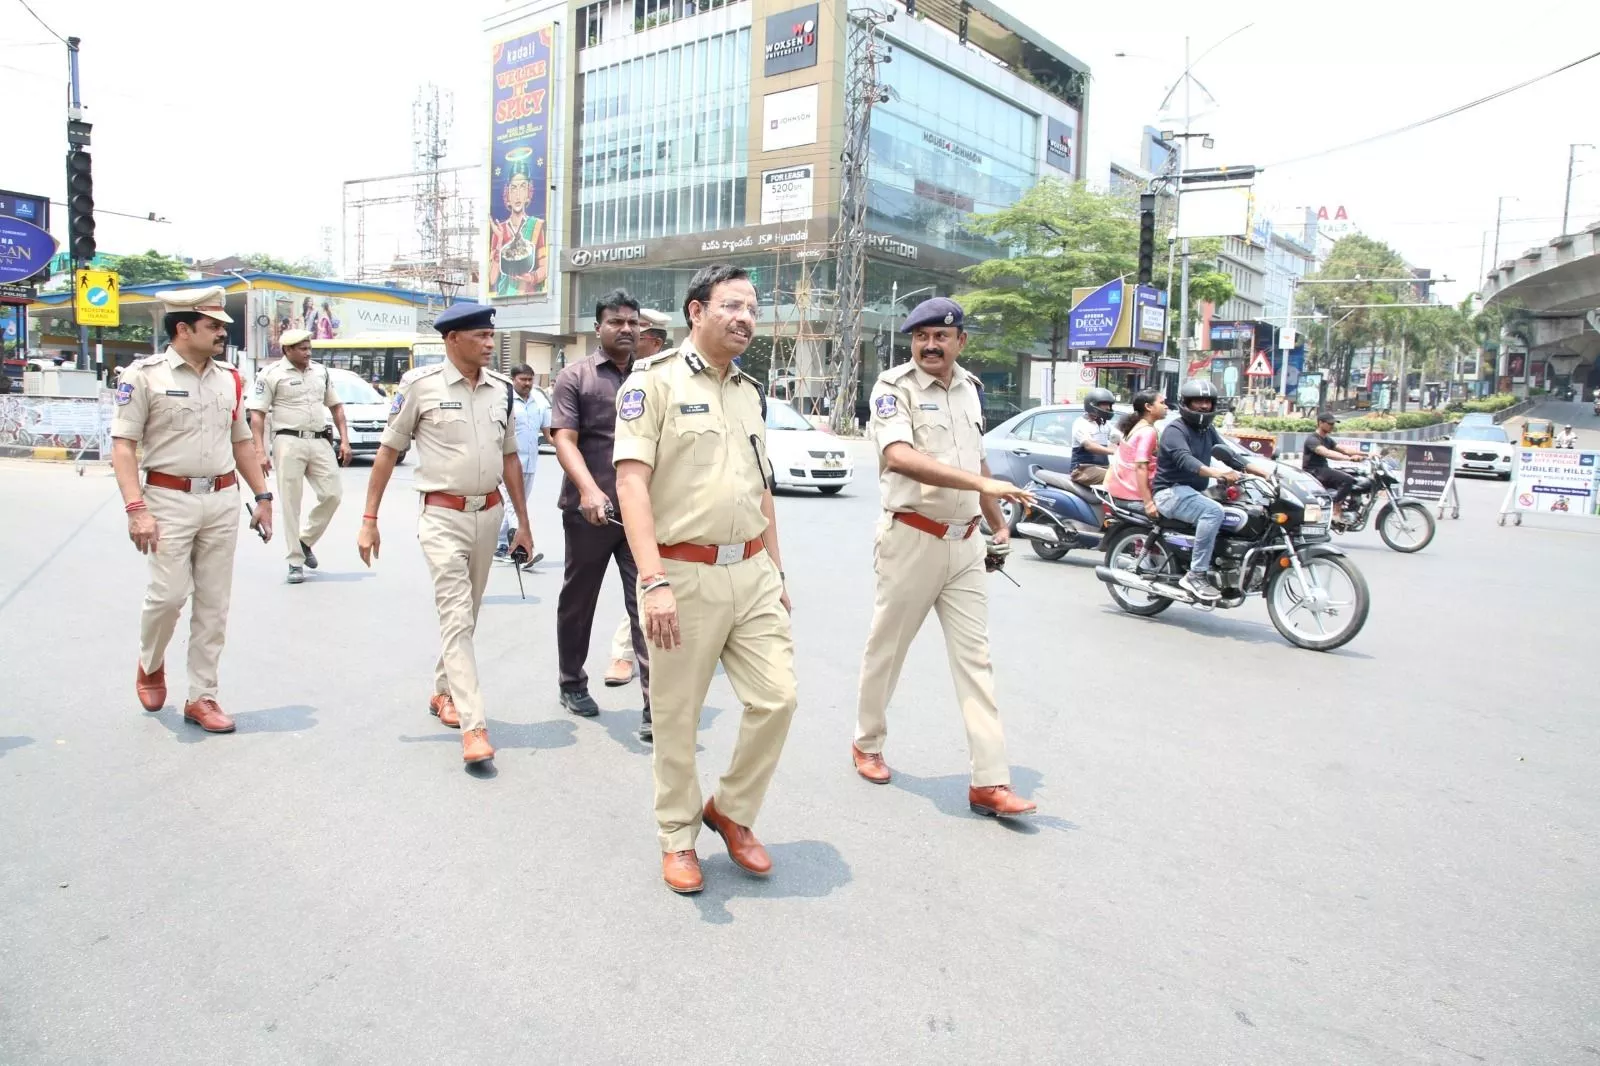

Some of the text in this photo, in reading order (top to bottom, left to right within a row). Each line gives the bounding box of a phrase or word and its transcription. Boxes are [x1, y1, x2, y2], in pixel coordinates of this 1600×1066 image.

[766, 36, 803, 54] WOXSEN
[495, 89, 546, 124] SPICY
[779, 113, 811, 124] JOHNSON
[770, 170, 805, 182] FOR LEASE
[758, 229, 809, 245] JSP Hyundai
[593, 244, 646, 262] HYUNDAI
[870, 234, 918, 260] HYUNDAI
[357, 308, 410, 325] VAARAHI
[1075, 317, 1113, 329] DECCAN
[1520, 465, 1593, 475] JUBILEE HILLS
